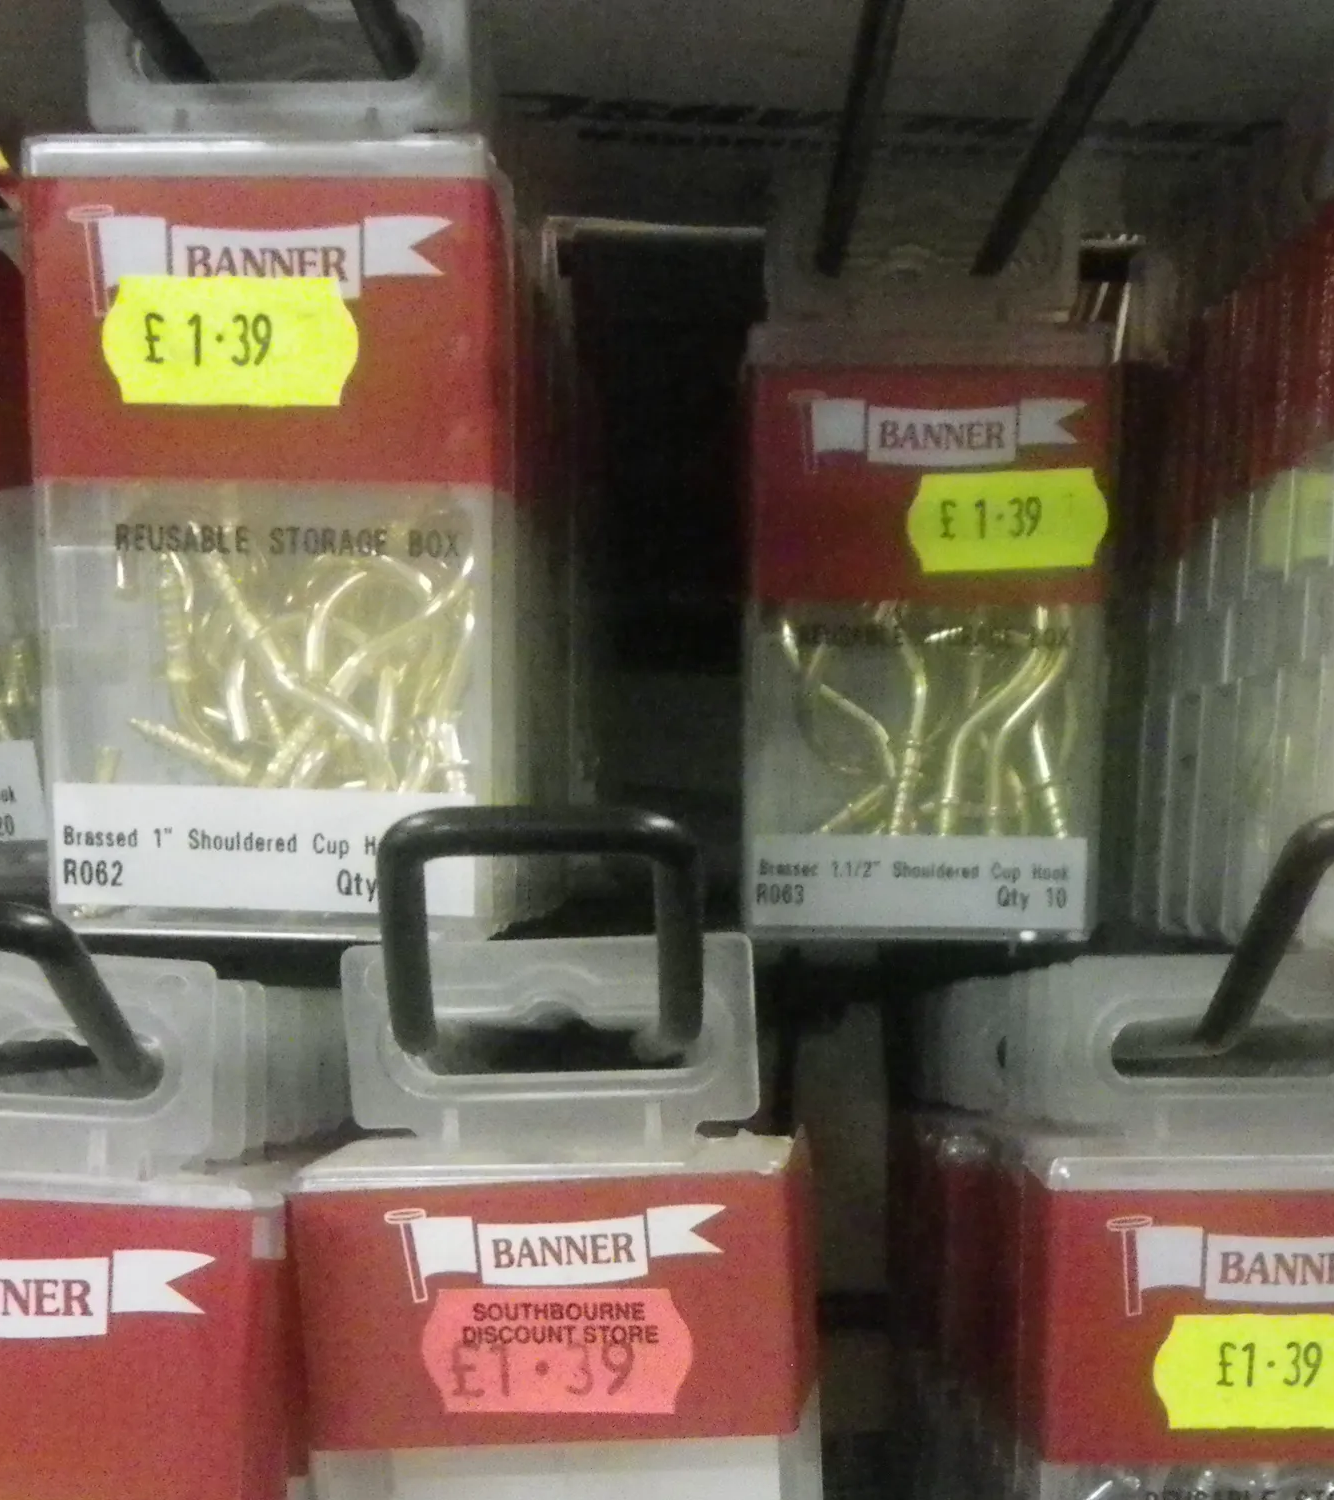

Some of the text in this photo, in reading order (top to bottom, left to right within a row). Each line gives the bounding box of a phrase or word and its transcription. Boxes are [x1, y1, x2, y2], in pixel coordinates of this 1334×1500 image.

[186, 245, 348, 281] BANNER
[879, 419, 1006, 451] BANNER
[115, 522, 461, 557] REUSABLE STORAGE BOX
[63, 825, 138, 848] Brassed
[188, 828, 298, 854] Shouldered
[312, 833, 350, 860] Cup
[63, 859, 124, 888] R062
[337, 869, 378, 903] Qty
[990, 861, 1021, 883] Cup
[997, 885, 1067, 912] Qty 10
[491, 1232, 636, 1269] BANNER
[472, 1301, 646, 1322] SOUTHBOURNE
[462, 1325, 659, 1345] DISCOUNT STORE
